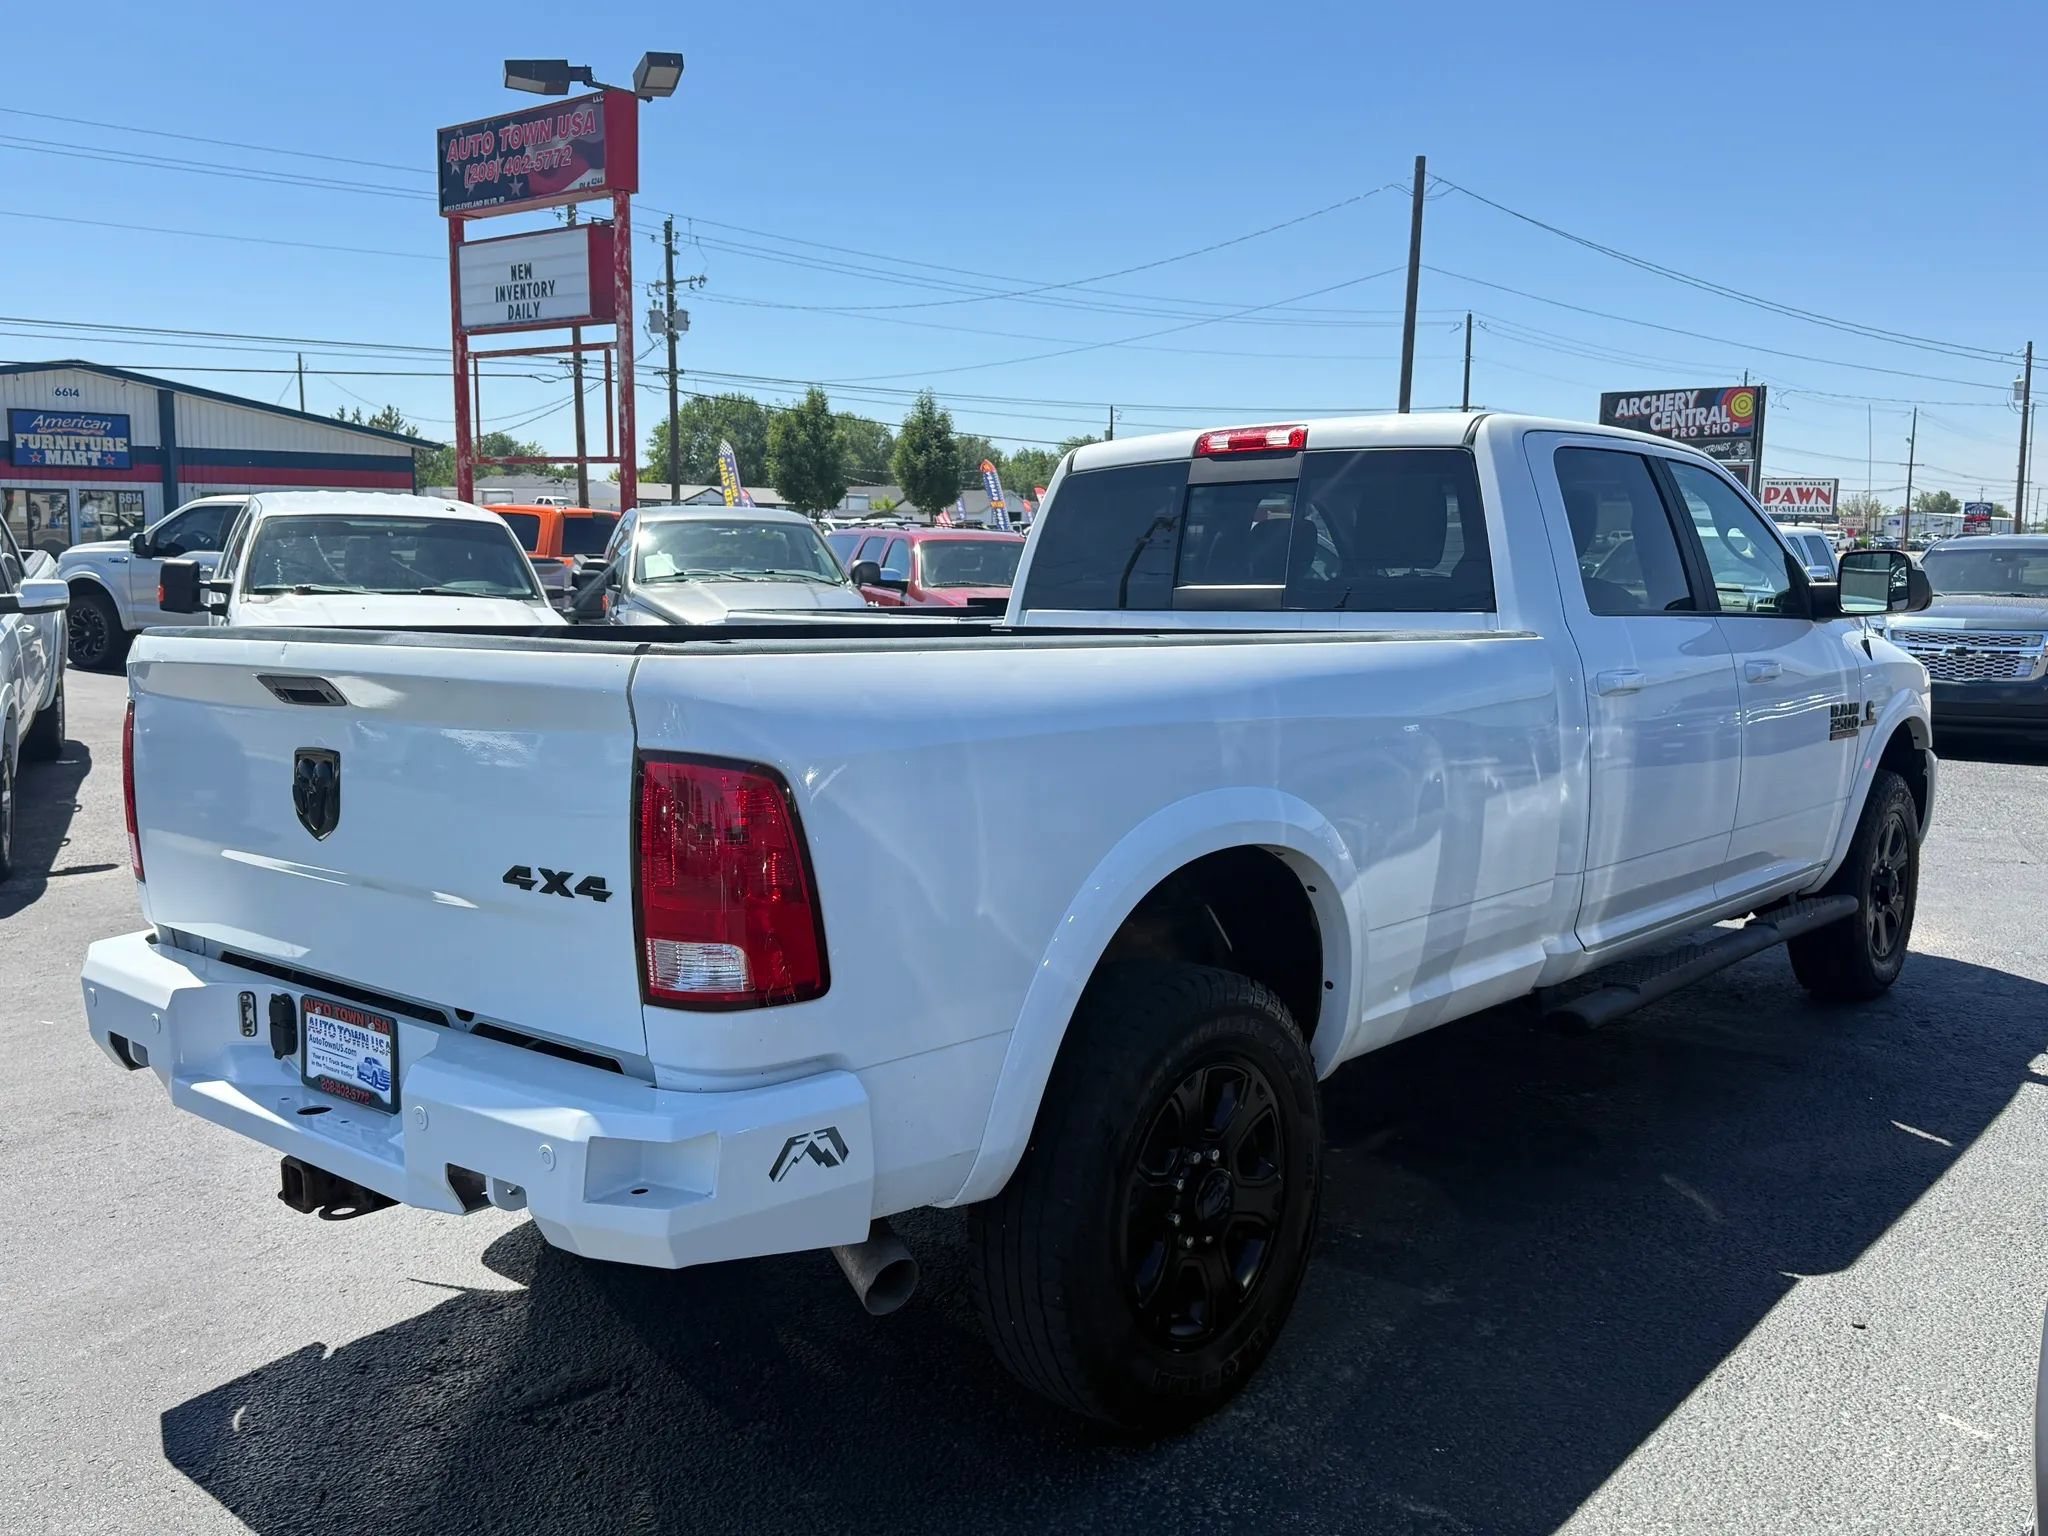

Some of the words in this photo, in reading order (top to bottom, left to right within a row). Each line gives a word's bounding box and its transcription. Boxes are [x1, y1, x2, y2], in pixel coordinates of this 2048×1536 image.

[446, 131, 495, 163] AUTO
[499, 118, 553, 152] TOWN
[557, 109, 596, 139] USA
[464, 159, 500, 188] (208)
[503, 145, 573, 177] 402-5772
[455, 200, 483, 211] CLEVELAND
[510, 262, 532, 281] NEW
[495, 280, 555, 303] INVENTORY
[508, 301, 540, 321] DAILY
[54, 387, 80, 398] 6614
[1615, 391, 1699, 418] ARCHERY
[30, 415, 112, 431] American
[1650, 405, 1731, 431] CENTRAL
[1671, 426, 1698, 439] PRO
[1703, 422, 1740, 435] SHOP
[14, 434, 128, 452] FURNITURE
[45, 450, 102, 466] MART
[118, 493, 142, 504] 6614
[1763, 487, 1832, 505] PAWN
[1830, 702, 1859, 718] RAM
[1830, 715, 1859, 731] 2500
[502, 865, 613, 903] 4X4
[304, 1000, 332, 1017] AUTO
[335, 1006, 365, 1026] TOWN
[366, 1015, 388, 1032] USA
[308, 1016, 337, 1039] AUTO
[337, 1025, 369, 1050] TOWN
[371, 1035, 391, 1056] USA
[308, 1034, 357, 1057] AutoTownUS.com
